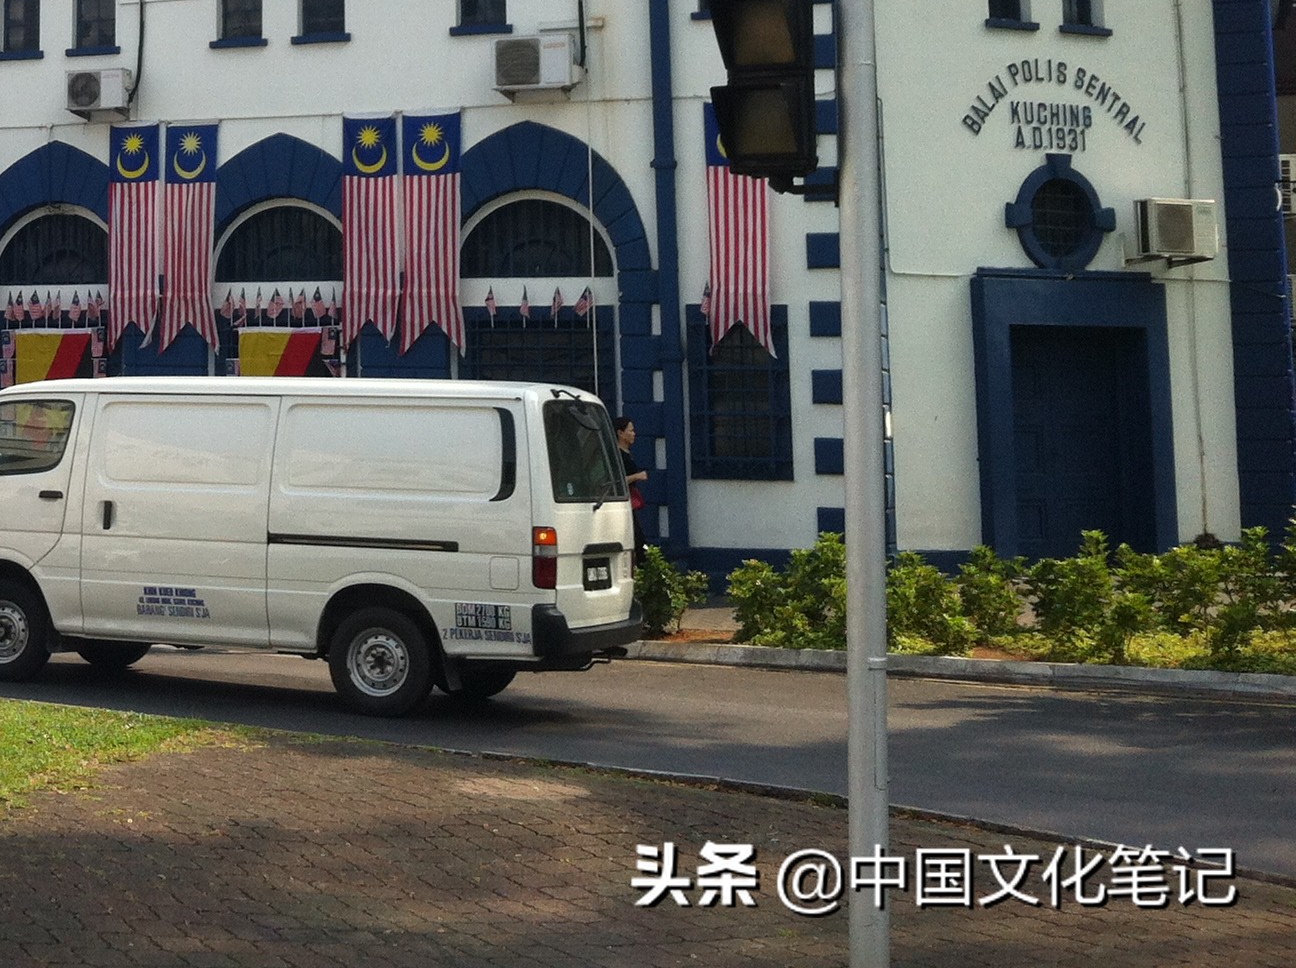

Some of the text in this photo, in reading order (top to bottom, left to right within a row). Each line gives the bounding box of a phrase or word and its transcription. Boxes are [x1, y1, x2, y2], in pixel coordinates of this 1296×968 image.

[962, 58, 1146, 145] BALAI POLIS SENTRAL
[1010, 100, 1092, 128] KUCHING
